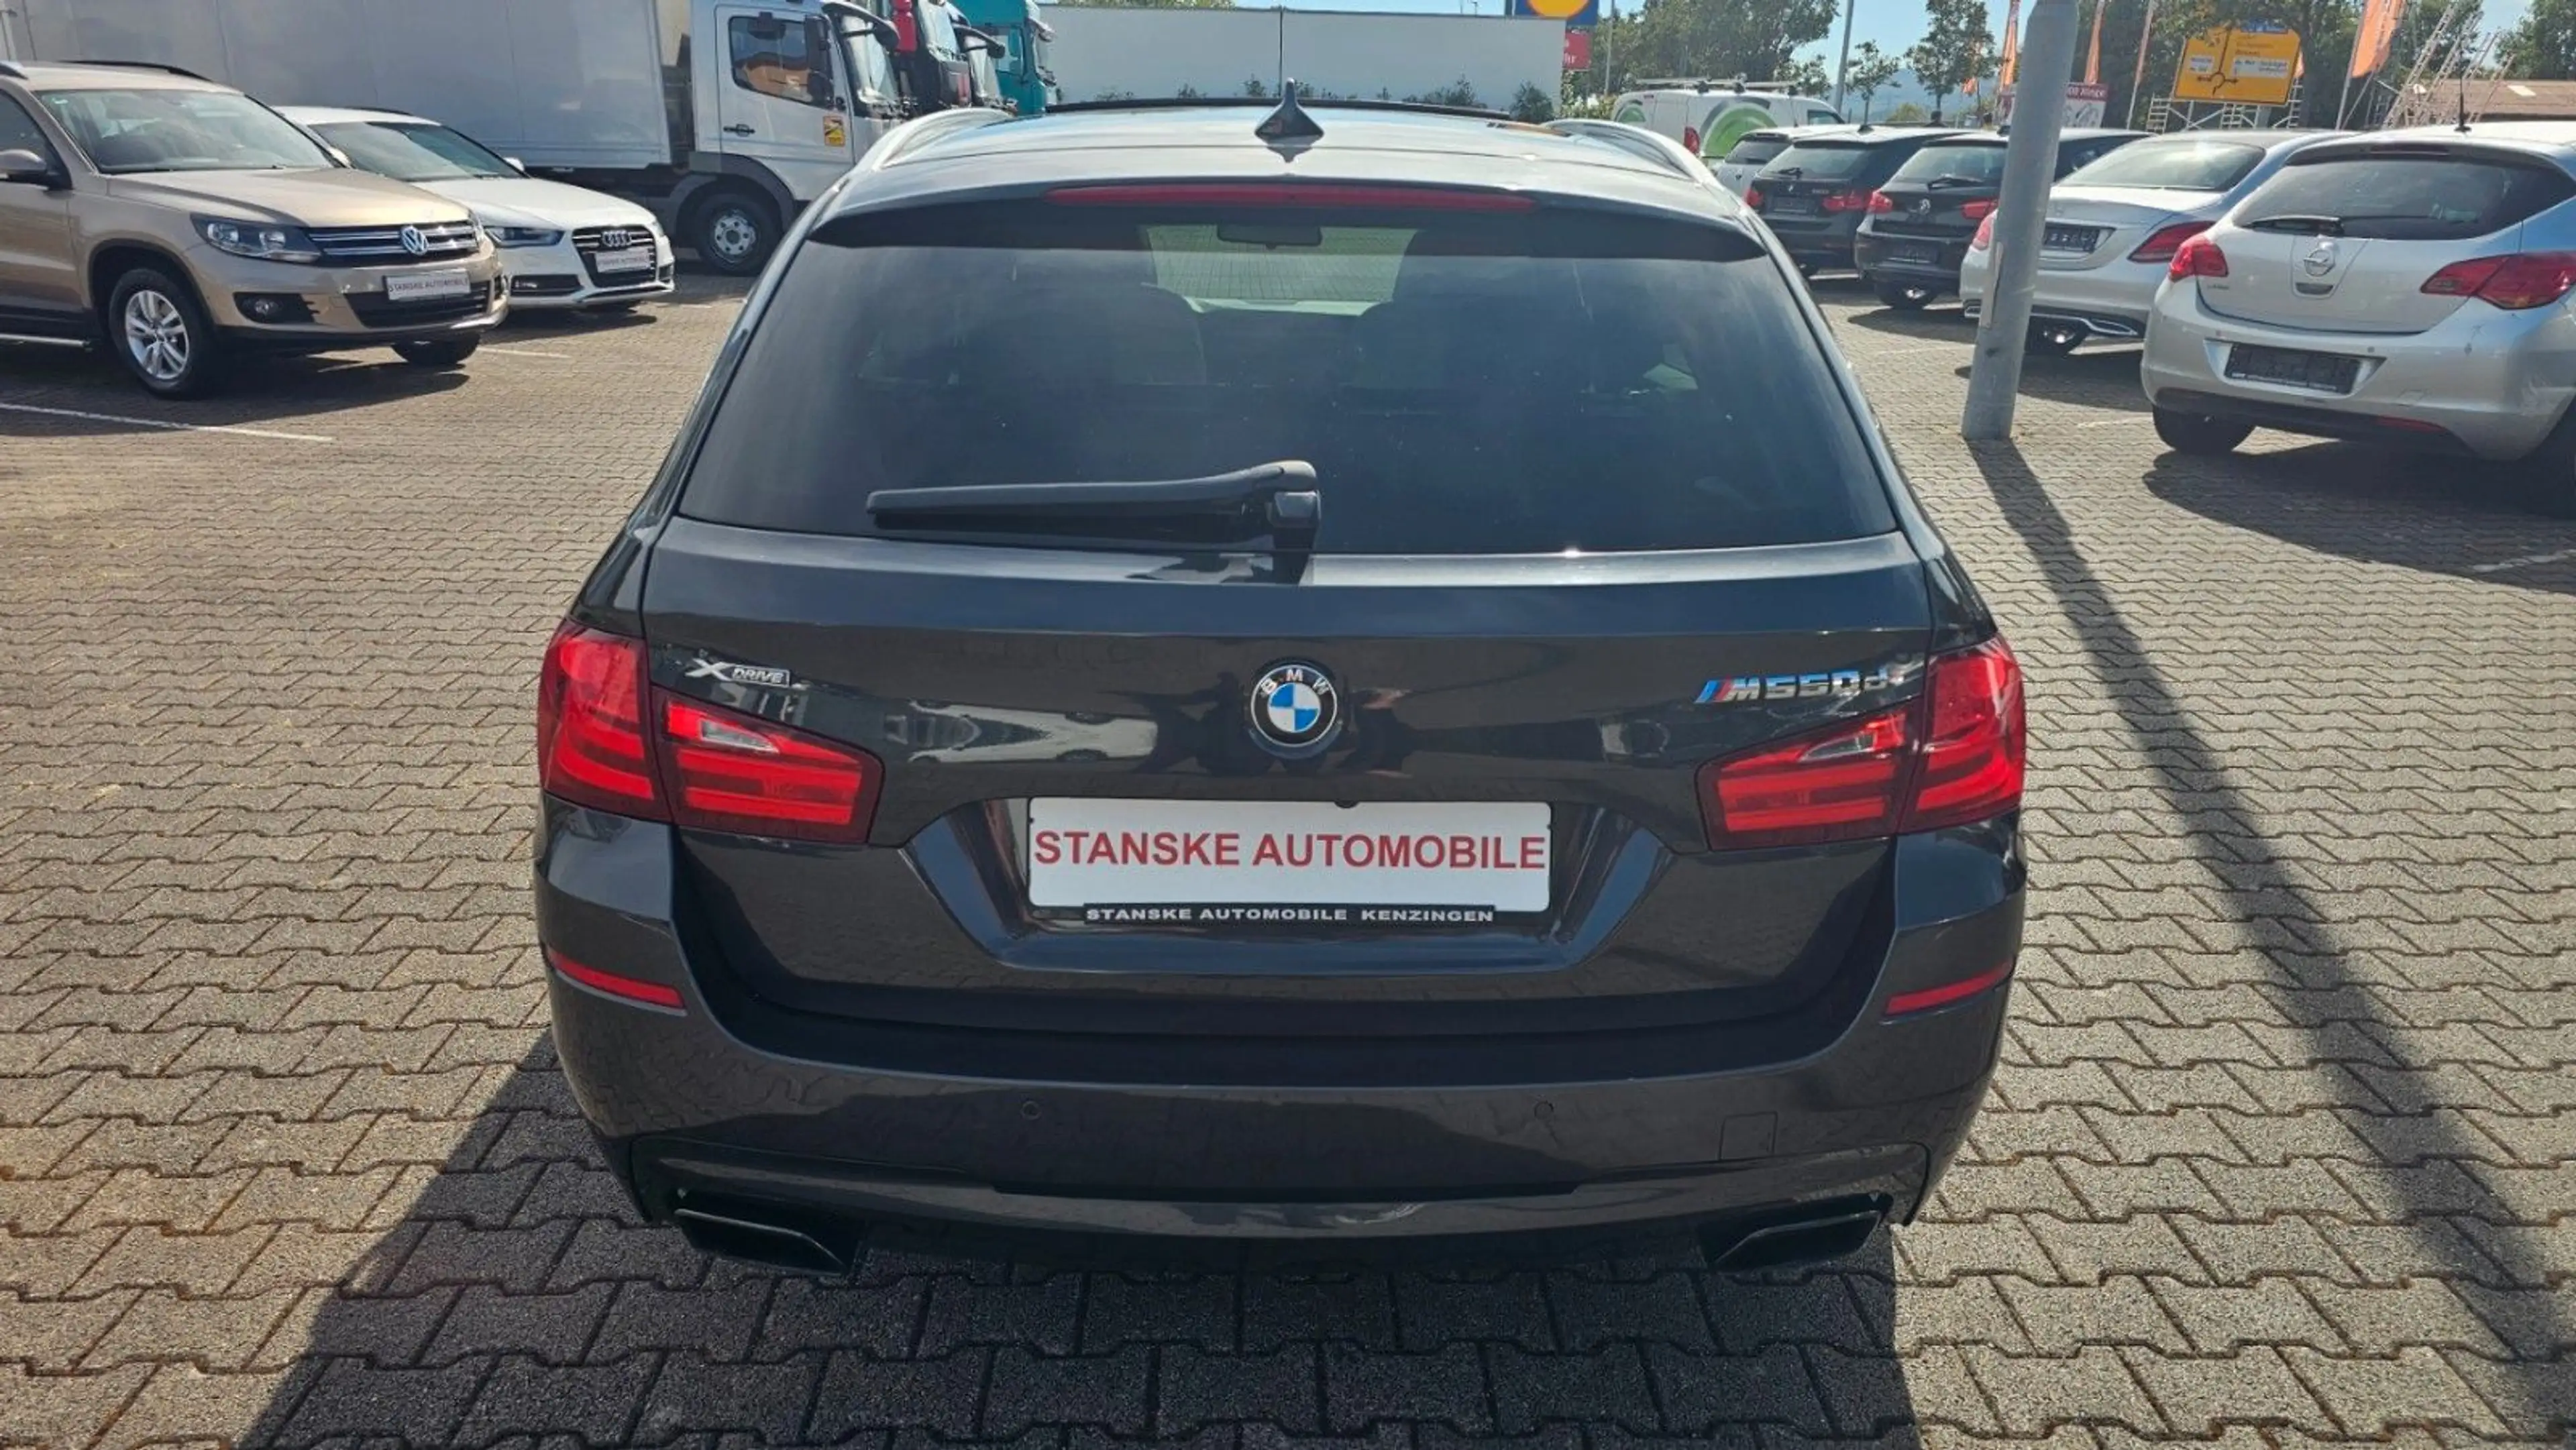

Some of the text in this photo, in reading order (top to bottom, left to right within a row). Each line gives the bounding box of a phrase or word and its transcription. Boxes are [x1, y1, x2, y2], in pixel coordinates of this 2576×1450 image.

[1260, 669, 1330, 695] BMW
[1034, 831, 1546, 869] STANSKE AUTOMOBILE
[1086, 909, 1494, 922] STANSKE AUTOMOBILE KENZINGEN
